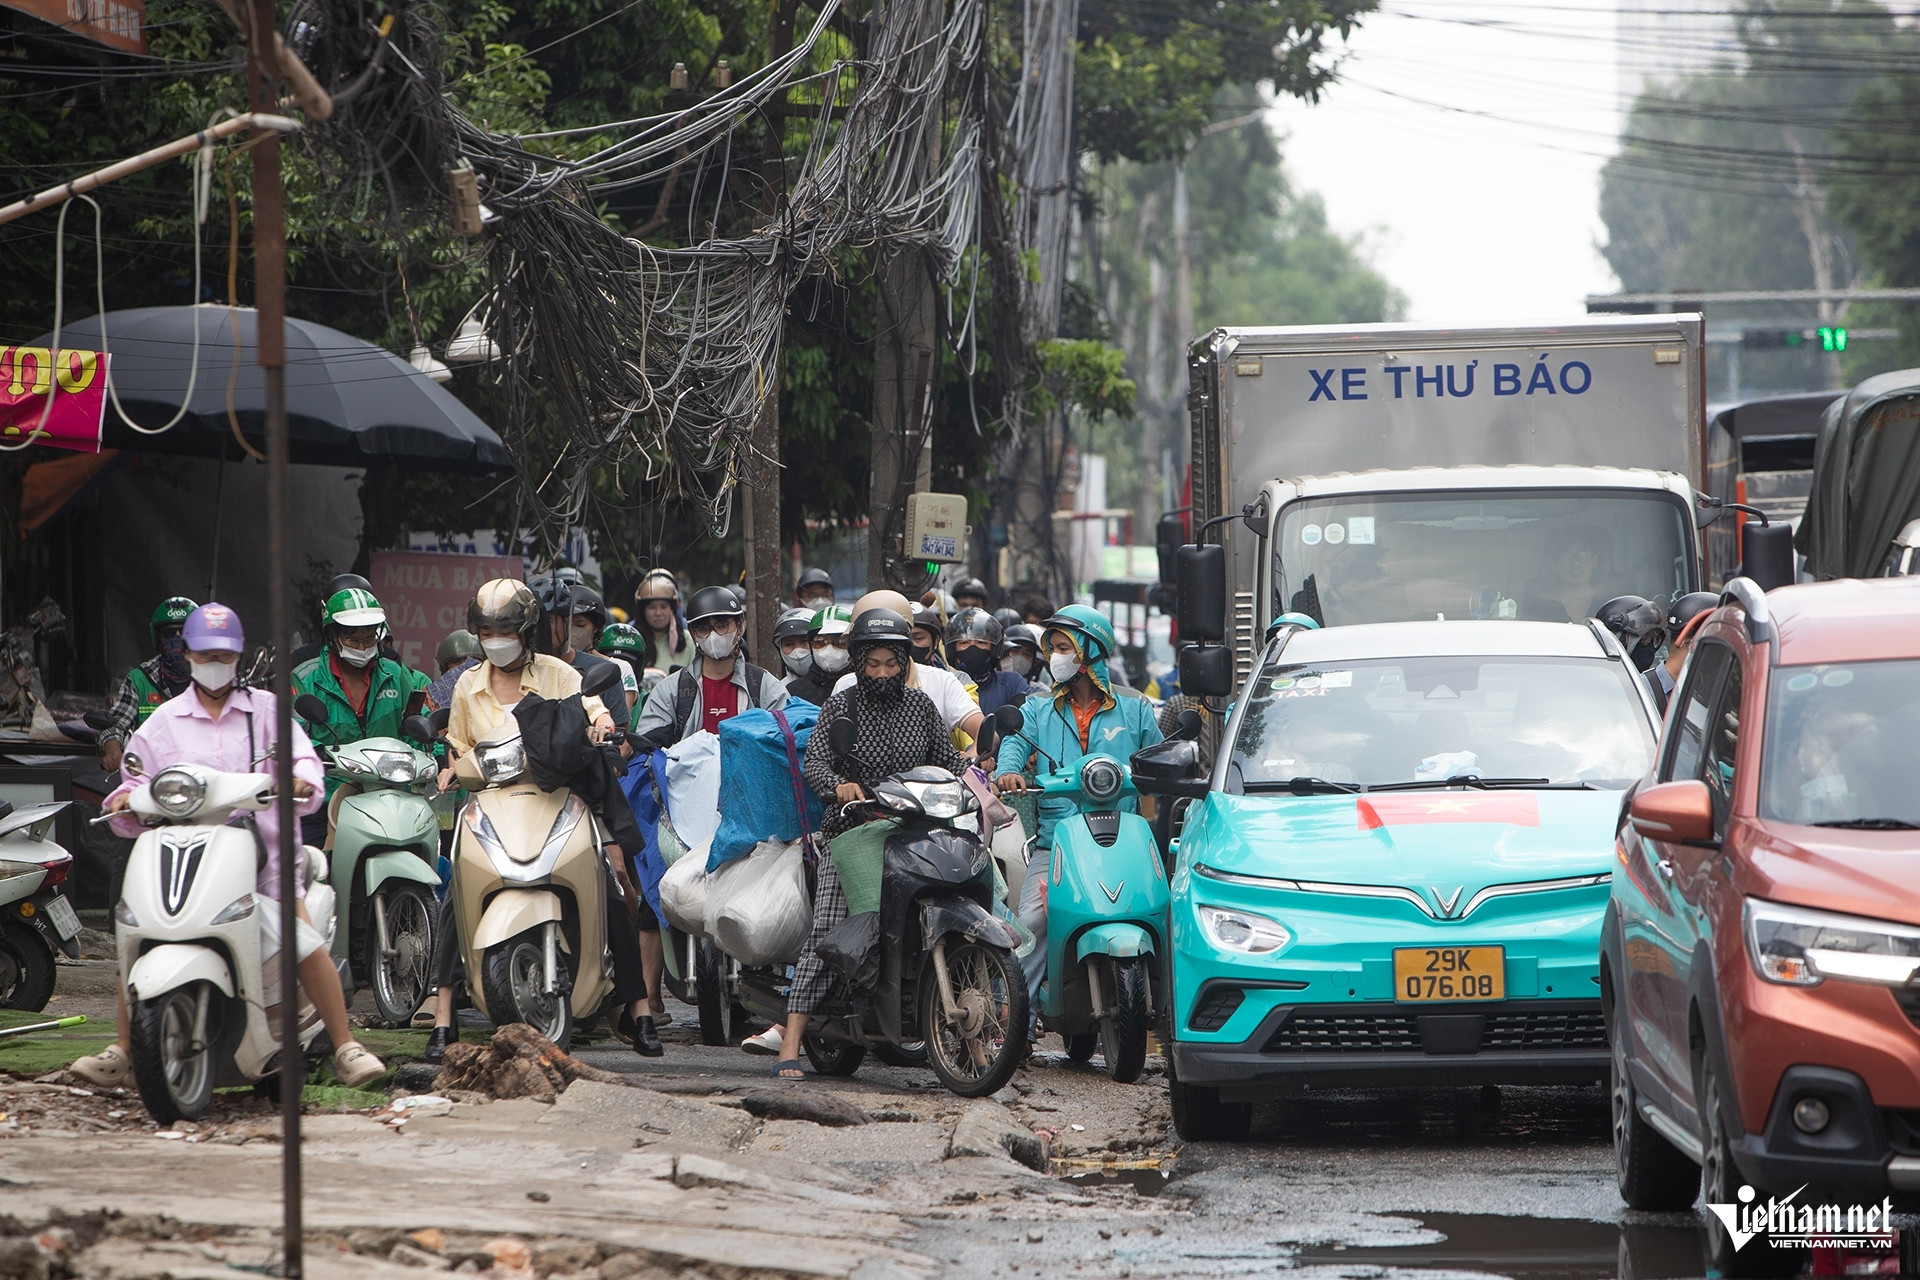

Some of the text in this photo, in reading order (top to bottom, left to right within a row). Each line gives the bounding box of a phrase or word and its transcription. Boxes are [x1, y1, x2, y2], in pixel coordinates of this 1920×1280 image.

[1308, 353, 1592, 401] XE THƯ BÁO
[384, 562, 443, 590] MUA
[167, 609, 187, 617] Grab
[617, 636, 636, 646] Grab
[1276, 688, 1327, 699] TAXI
[1425, 950, 1472, 972] 29K
[1406, 975, 1493, 998] 076.08
